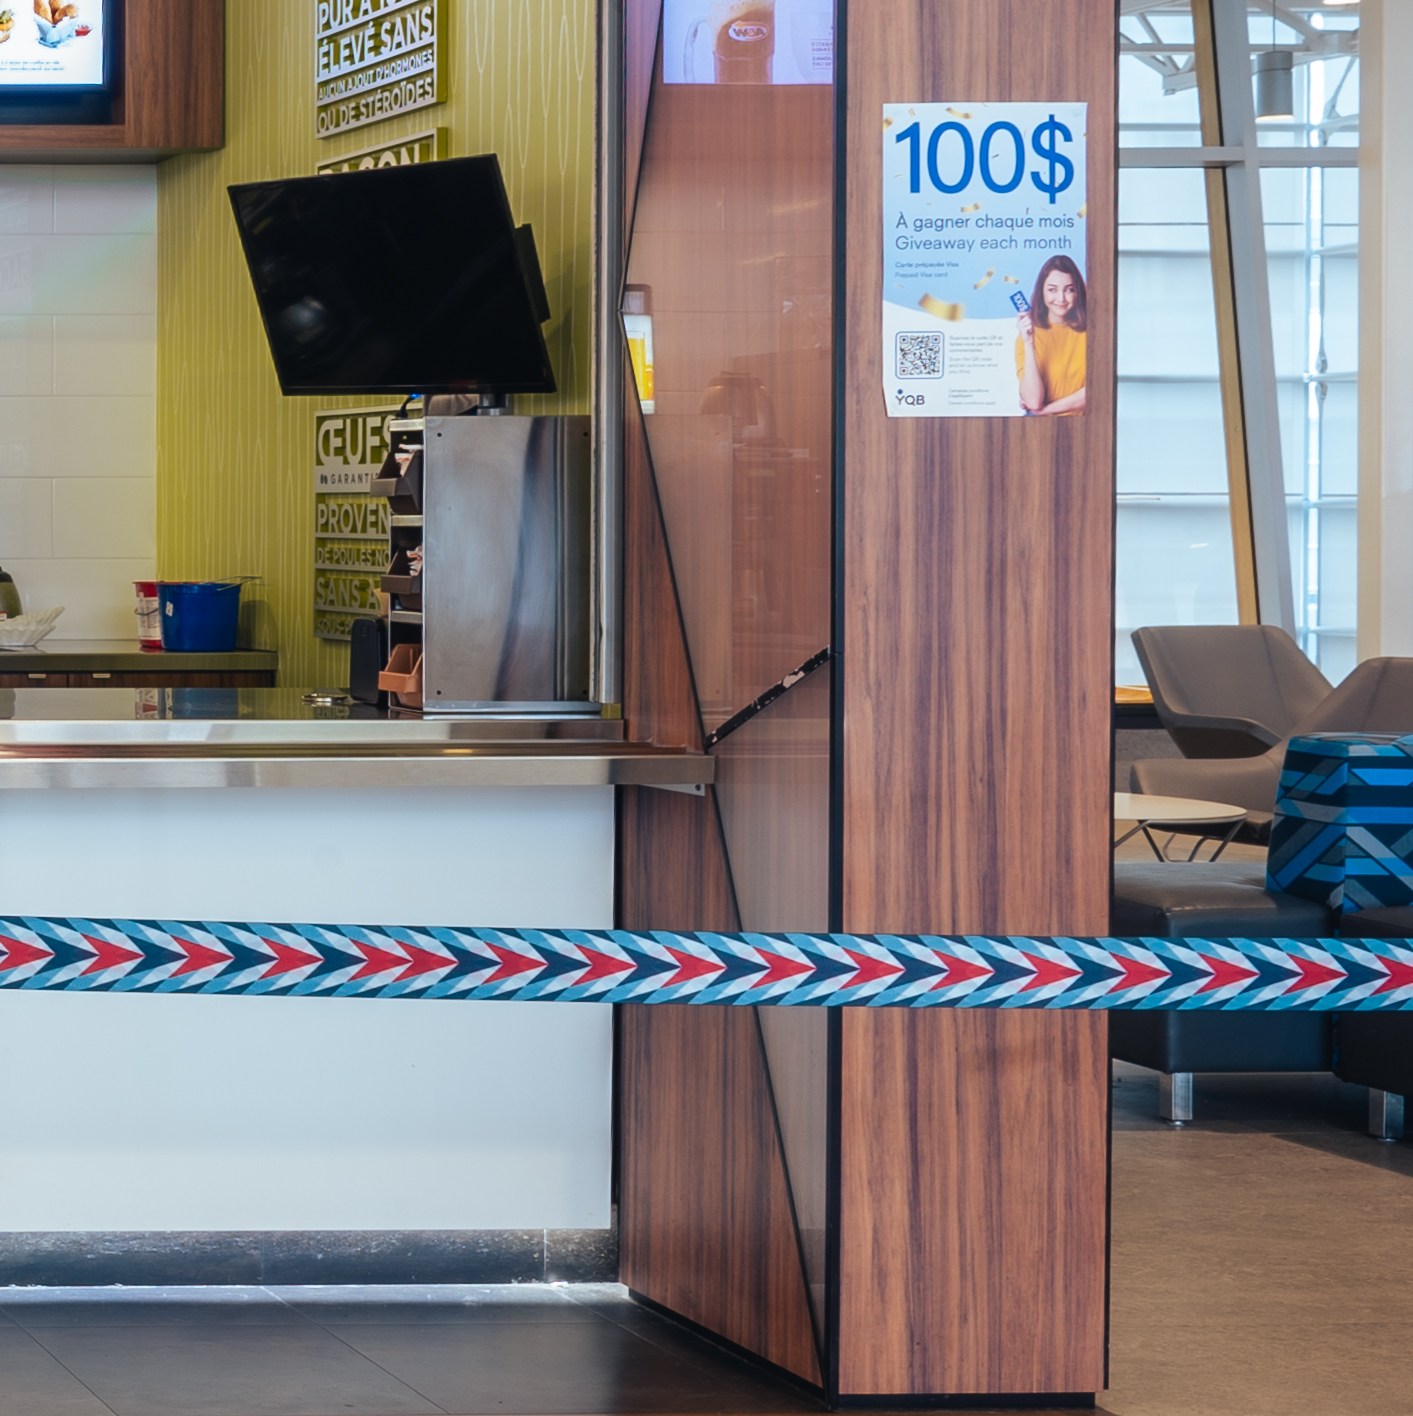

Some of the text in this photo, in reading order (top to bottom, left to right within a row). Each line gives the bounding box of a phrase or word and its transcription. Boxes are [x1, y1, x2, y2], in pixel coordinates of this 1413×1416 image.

[318, 5, 433, 78] ÉLEVÉ SANS
[318, 49, 433, 102] AUCUN AJOUT D'HORMONES
[317, 76, 433, 132] OU DE STÉROÏDES
[894, 113, 1075, 205] 100$
[895, 211, 1075, 235] À gagner chaque mois
[895, 235, 1073, 253] Giveaway each month
[895, 394, 926, 406] YQB
[317, 502, 390, 535] PROVEN
[317, 547, 330, 565] DE
[332, 547, 372, 567] POULES
[316, 576, 360, 610] SANS
